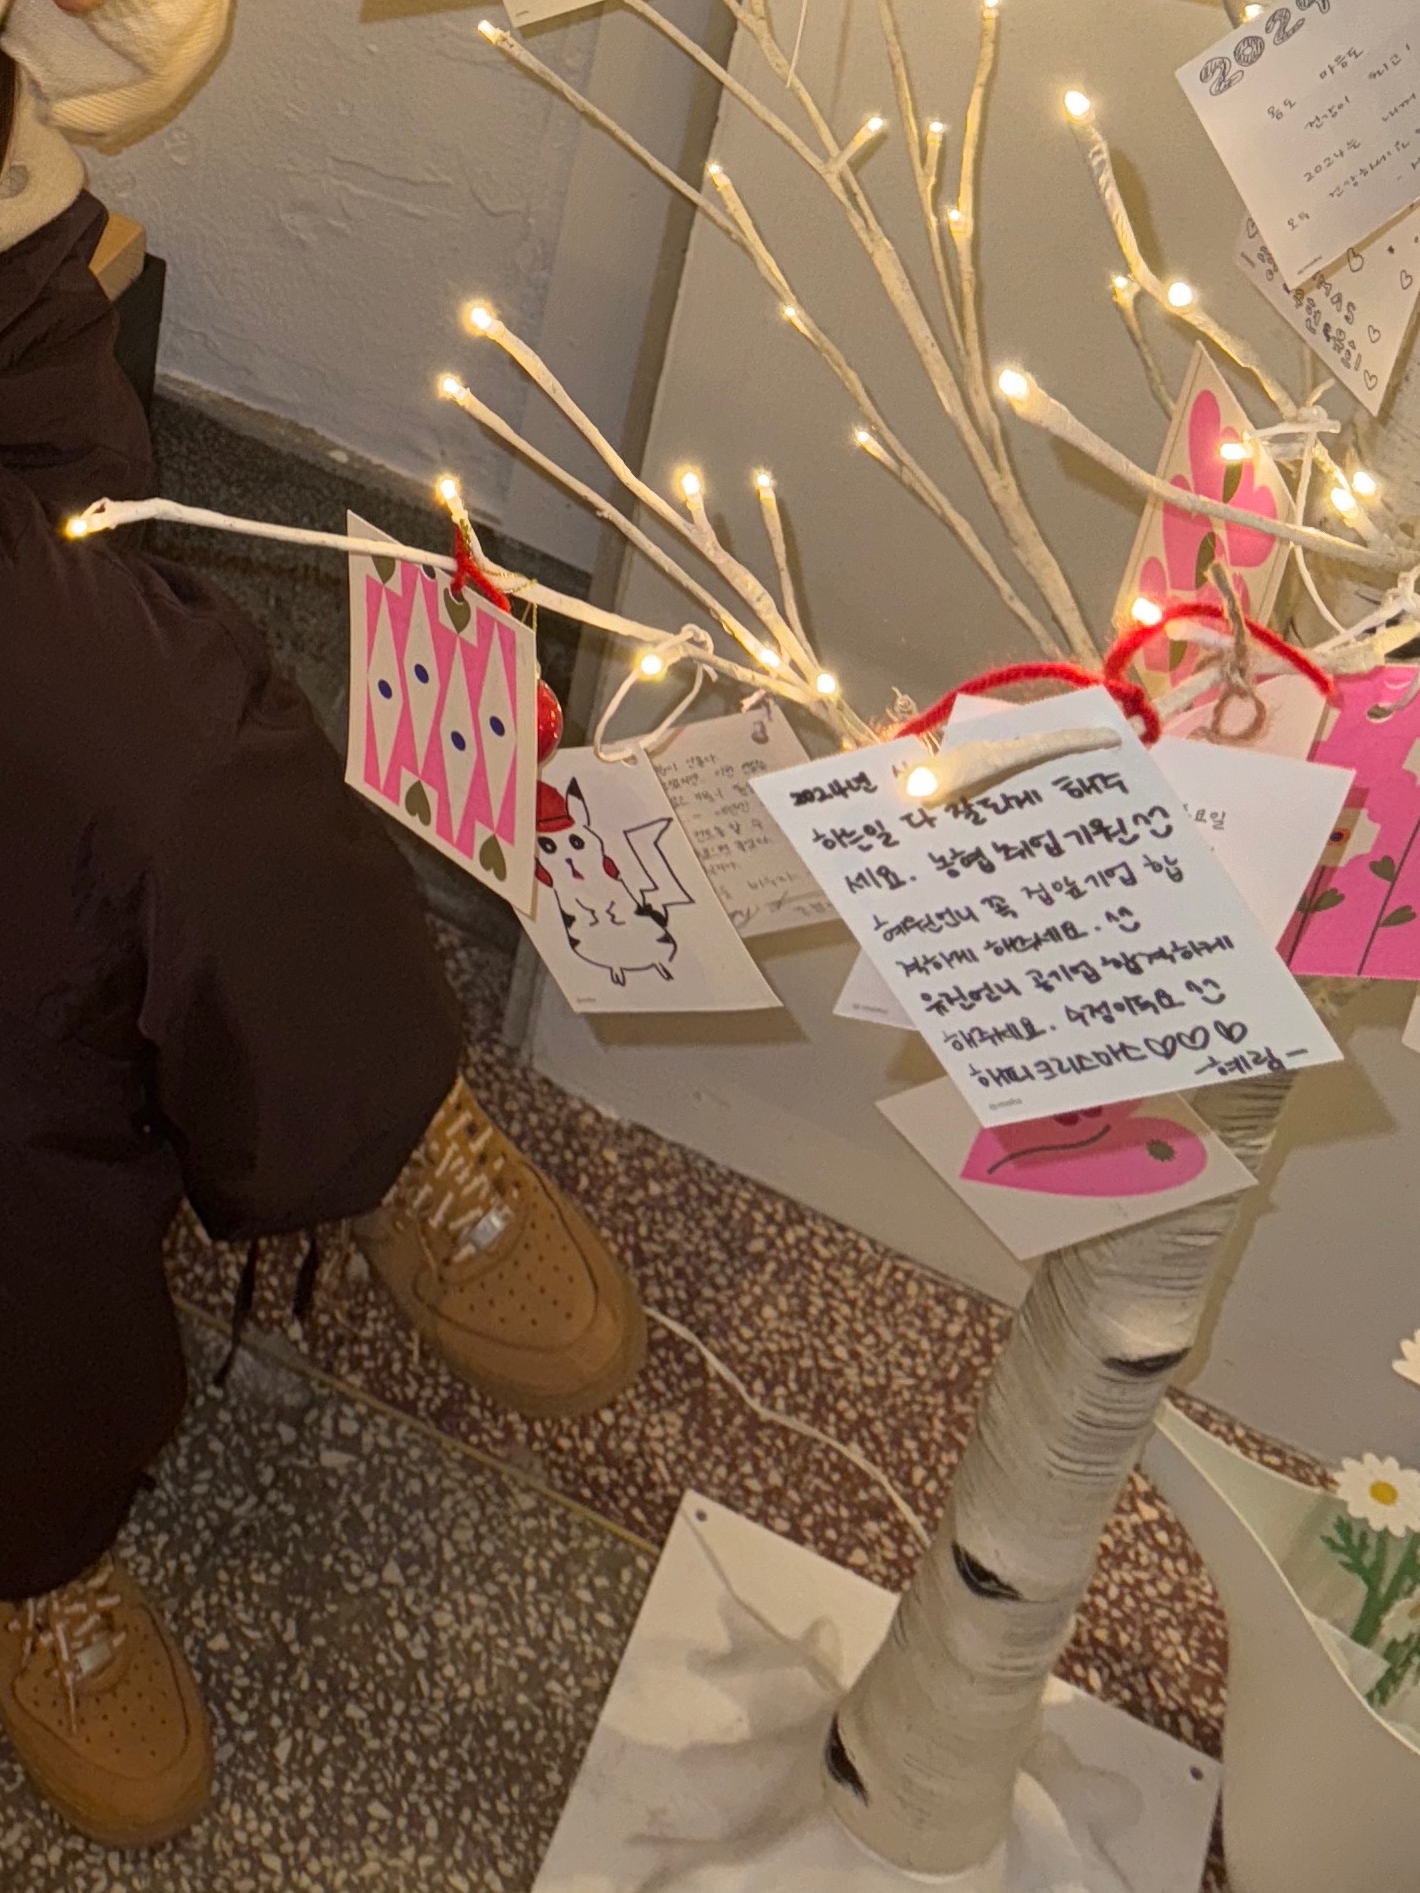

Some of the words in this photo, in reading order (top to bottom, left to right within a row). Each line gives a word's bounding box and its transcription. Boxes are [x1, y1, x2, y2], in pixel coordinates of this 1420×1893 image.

[1319, 46, 1365, 80] 마음도
[1304, 95, 1351, 130] 건강이
[789, 771, 879, 807] 2024년
[899, 808, 937, 830] 다
[1051, 772, 1130, 800] 해주
[927, 846, 996, 879] 농협
[991, 829, 1066, 862] 취업
[980, 895, 1018, 919] 꼭
[1142, 854, 1184, 883] 합
[895, 948, 980, 978] 격하게
[920, 978, 1022, 1016] 유진언니
[1025, 960, 1102, 992] 공기업
